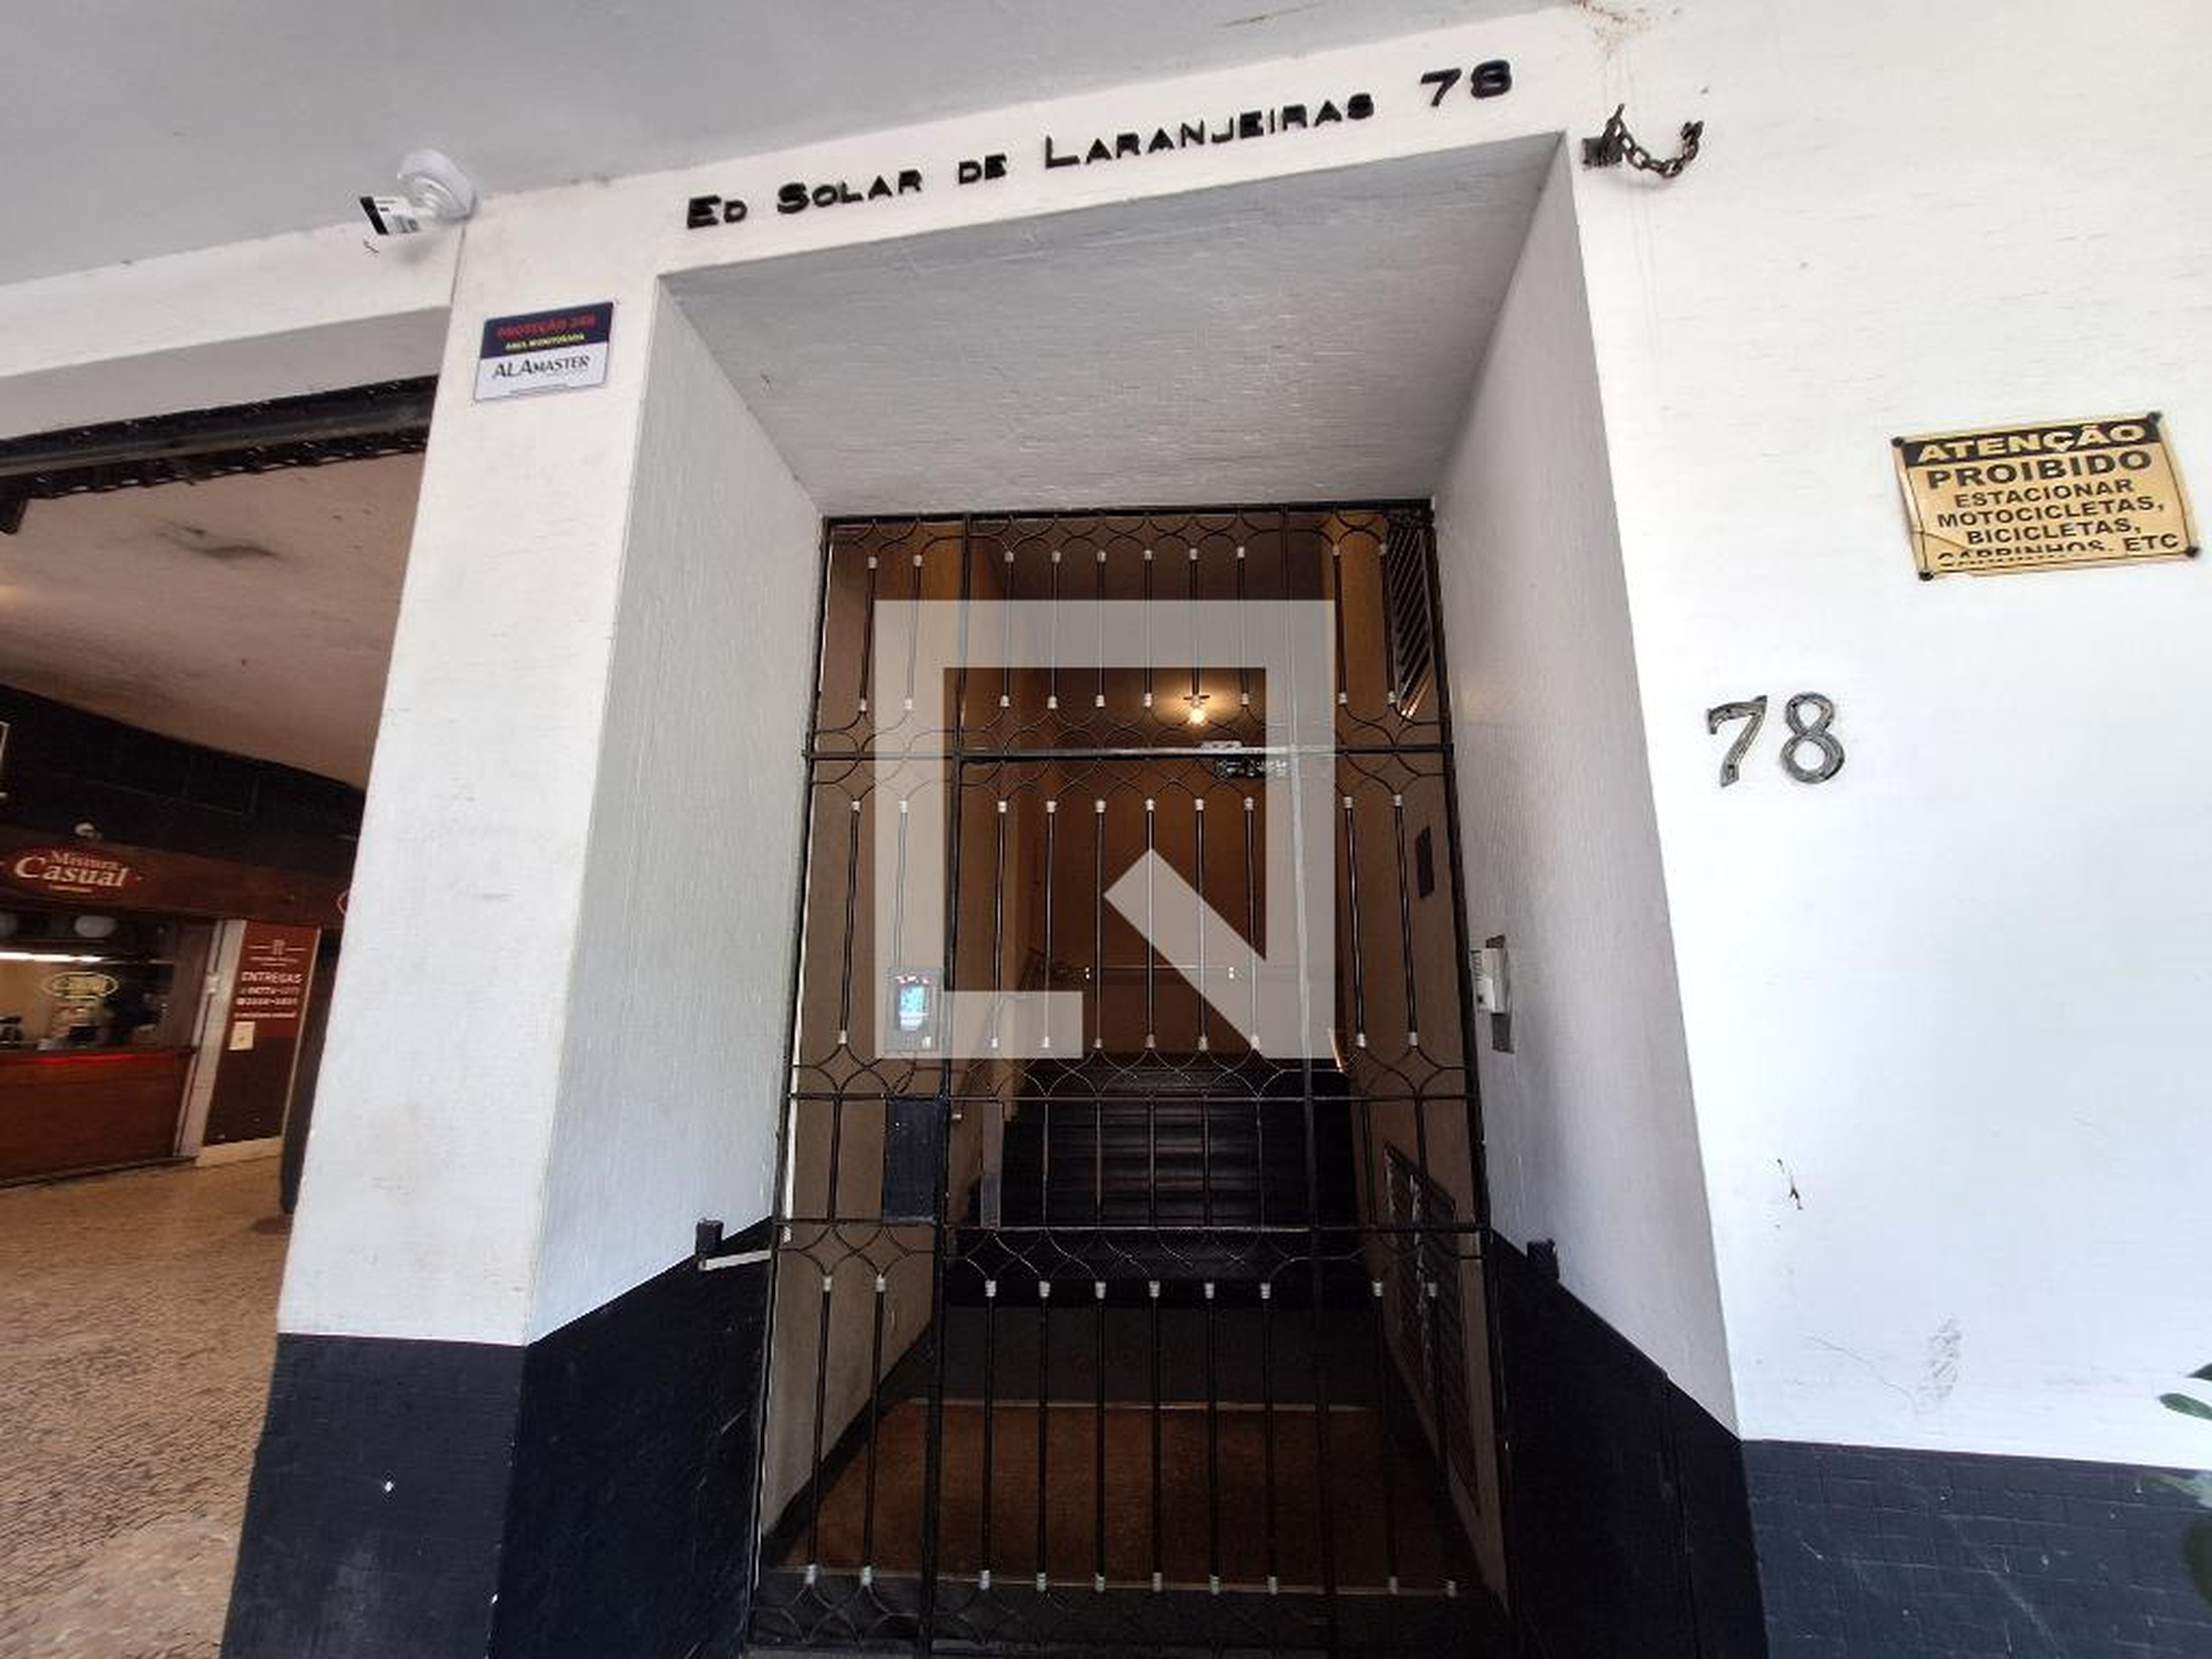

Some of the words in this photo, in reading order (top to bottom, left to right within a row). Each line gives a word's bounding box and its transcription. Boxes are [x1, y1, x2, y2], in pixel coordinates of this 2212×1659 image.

[957, 153, 1007, 185] DE
[1419, 59, 1513, 108] 78
[1918, 424, 2146, 463] ATENÇÃO
[1927, 450, 2152, 490] PROIBIDO
[1956, 478, 2135, 509] ESTACIONAR
[1937, 496, 2164, 528] MOTOCICLETAS,
[1967, 517, 2142, 546] BICICLETAS,
[2124, 533, 2179, 552] ETC
[1707, 691, 1845, 787] 78
[14, 857, 130, 887] Casual
[241, 971, 303, 984] ENTREGAS
